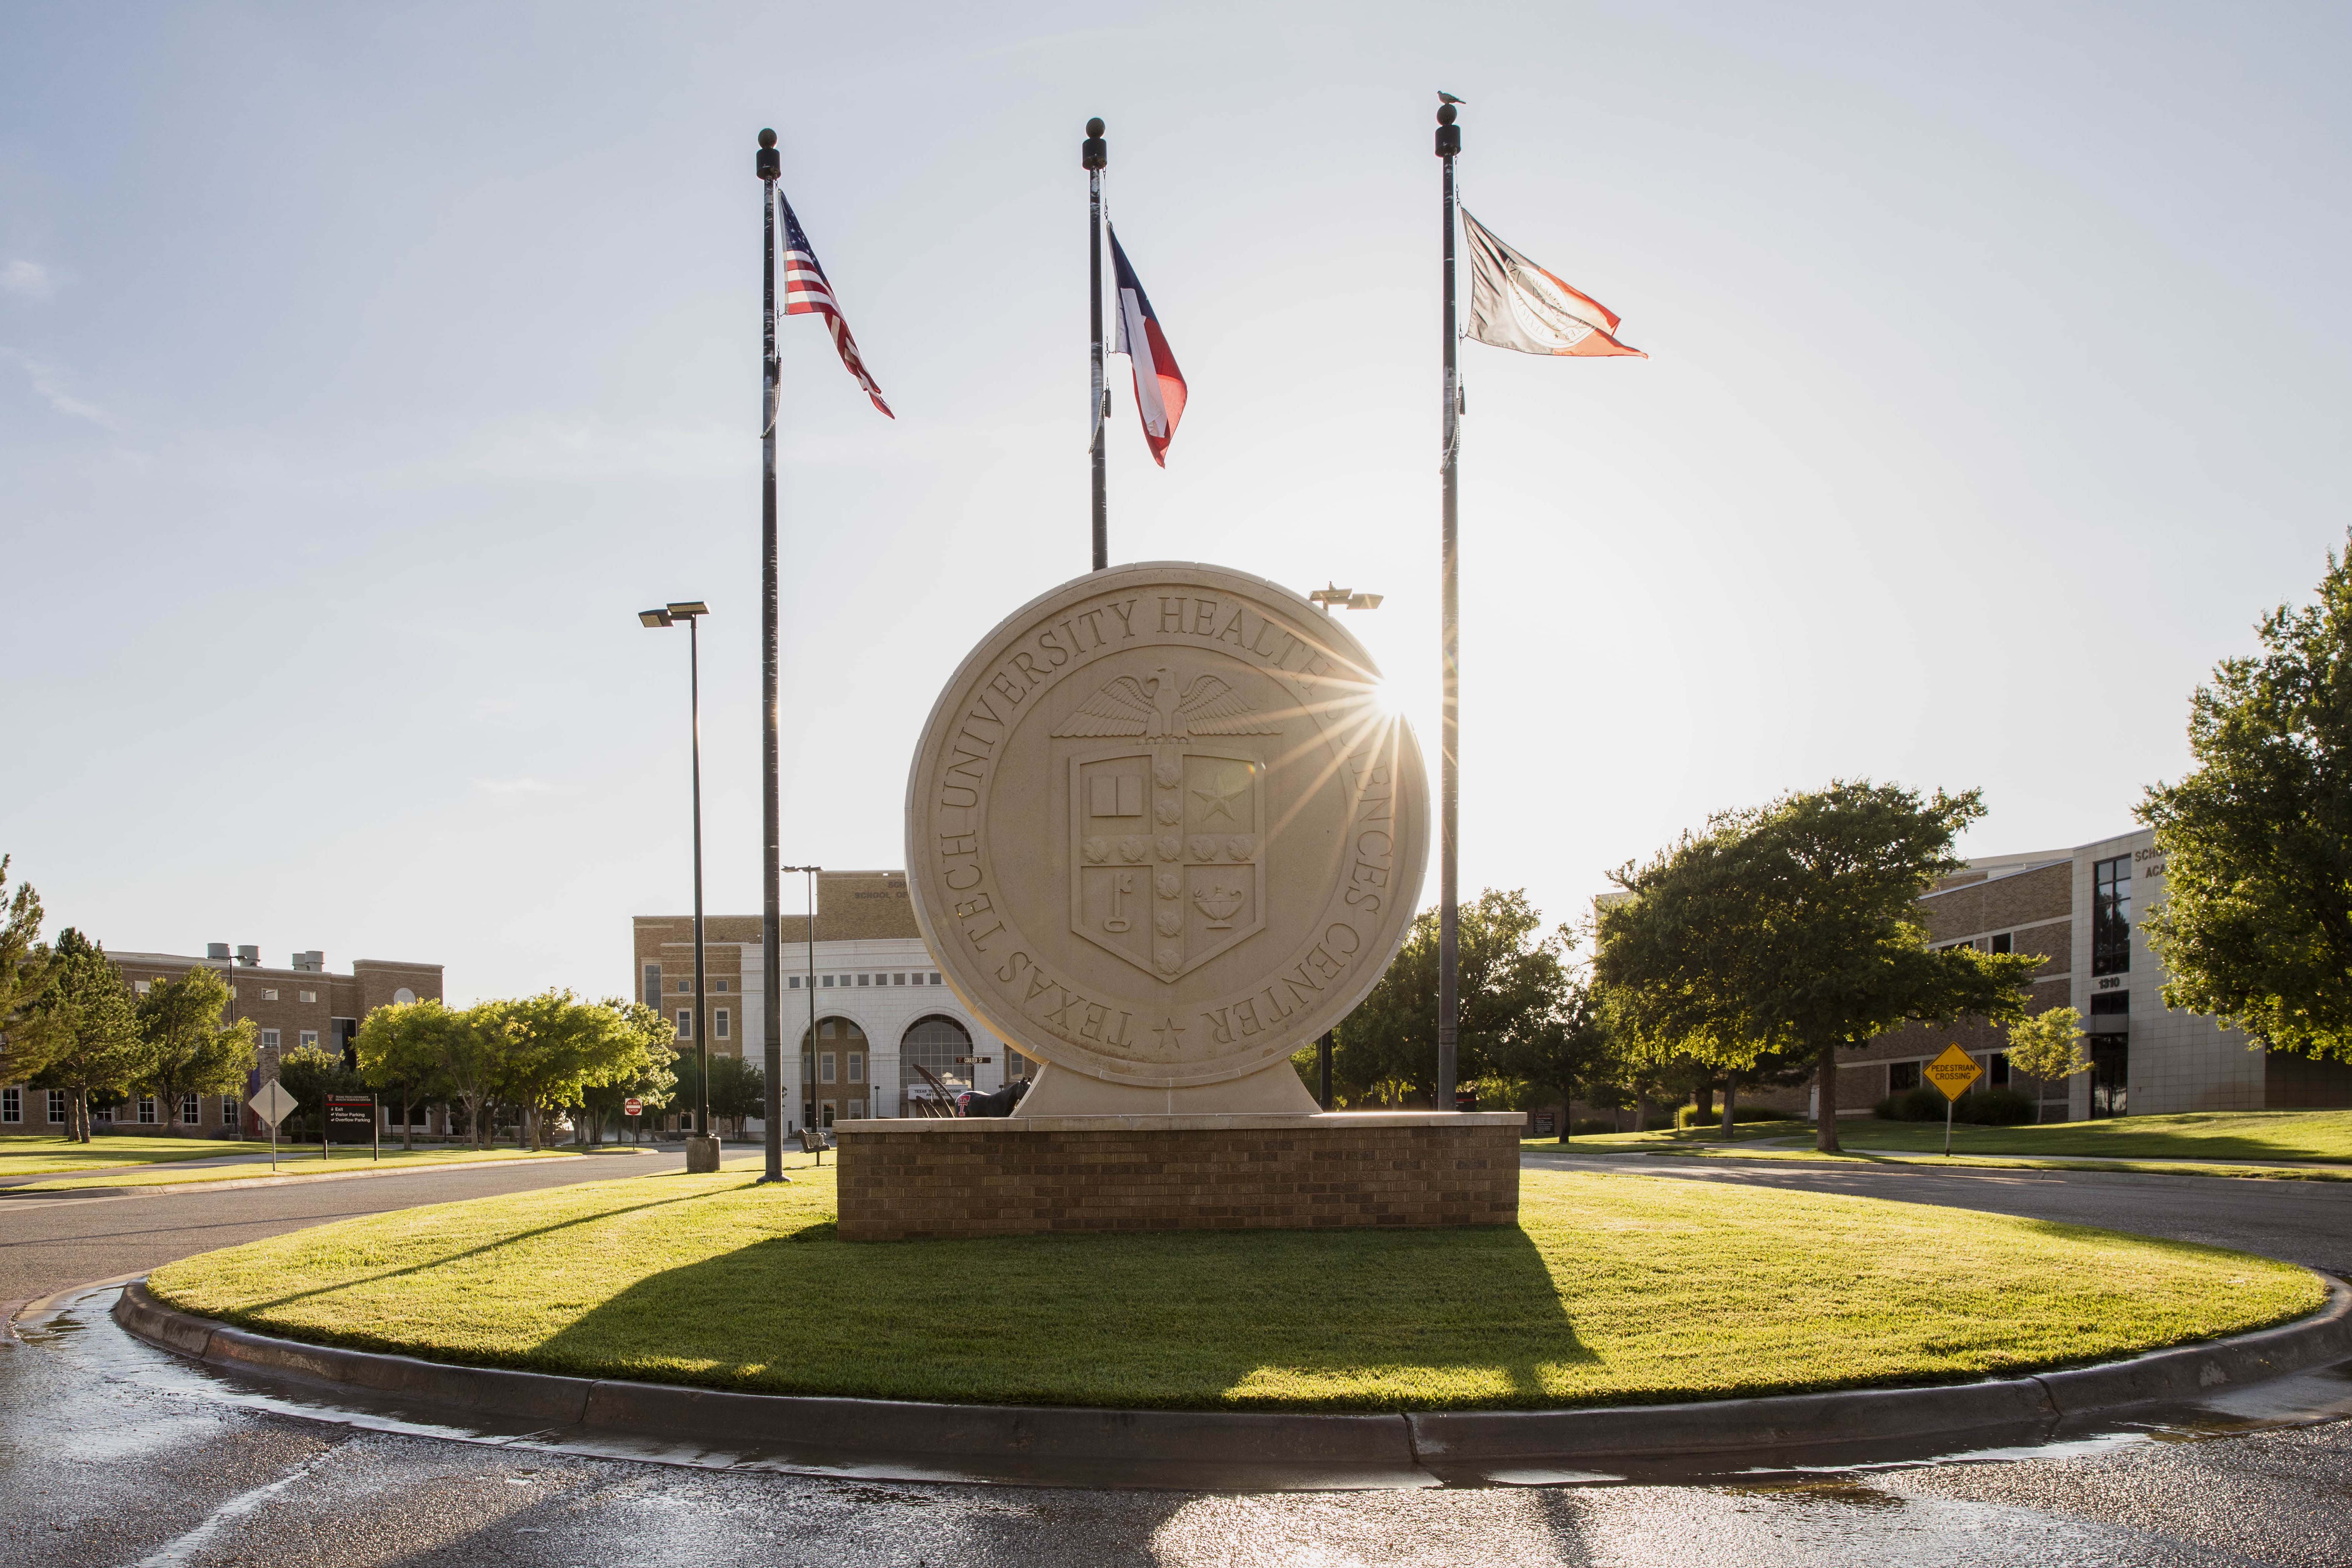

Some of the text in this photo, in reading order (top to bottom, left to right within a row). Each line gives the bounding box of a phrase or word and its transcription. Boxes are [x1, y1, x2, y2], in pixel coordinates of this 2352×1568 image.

[1156, 597, 1336, 696] HEALTH
[940, 599, 1138, 812] UNIVERSITY
[940, 829, 1006, 953] TECH
[994, 952, 1133, 1049] TEXAS
[1200, 923, 1360, 1044] CENTER
[2098, 977, 2120, 989] 1310
